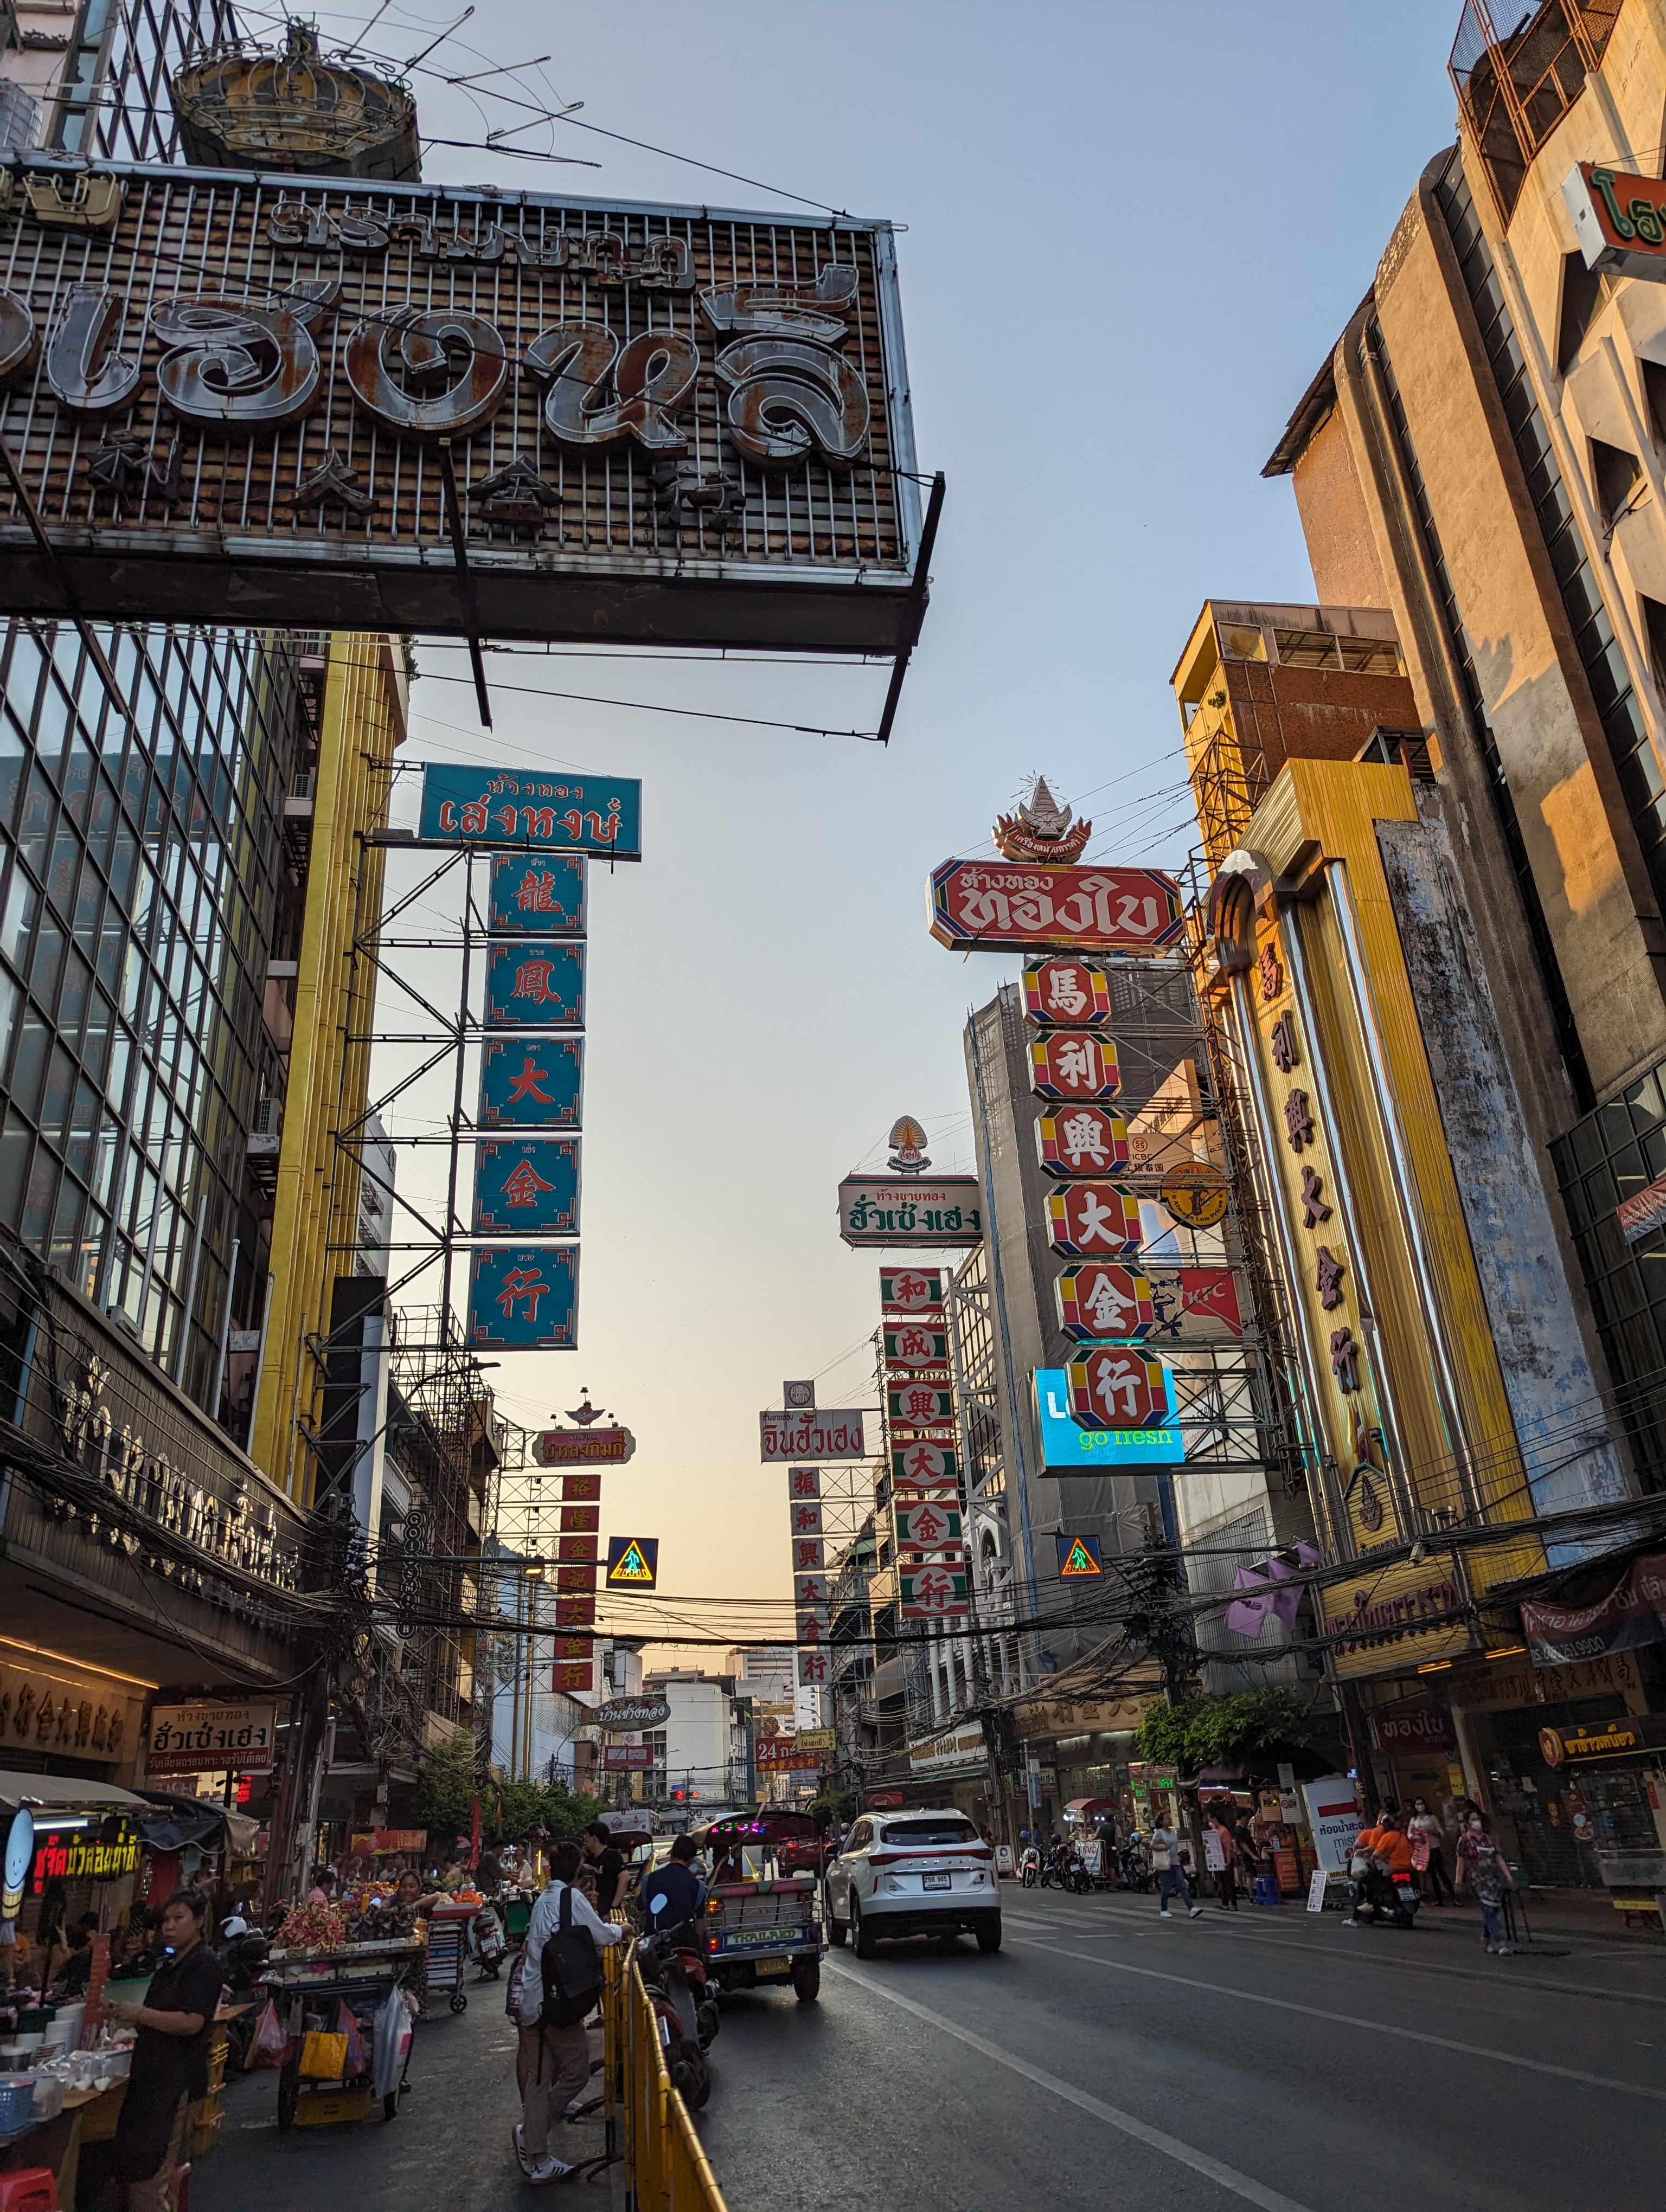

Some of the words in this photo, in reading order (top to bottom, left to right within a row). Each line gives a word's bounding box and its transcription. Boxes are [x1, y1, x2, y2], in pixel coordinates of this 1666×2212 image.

[487, 774, 584, 800] ห้างทอง
[439, 793, 624, 844] เล่งหงษ์
[1014, 832, 1080, 853] เครื่องหมายการค้า
[531, 858, 546, 867] ห้าง
[959, 868, 1053, 891] ห้างทอง
[522, 1144, 536, 1154] เล่ง
[876, 1187, 946, 1201] ห้างขายทอง
[848, 1193, 981, 1232] ฮั่วเซ่งเฮง
[1188, 1282, 1226, 1304] KFC
[1079, 1430, 1110, 1451] go
[1114, 1430, 1174, 1445] fresh
[177, 1709, 249, 1722] ห้างขายทอง
[599, 1703, 665, 1722] บ้านช่างทอง
[153, 1721, 266, 1751] ฮั่วเซ่งเฮง
[149, 1752, 218, 1769] รับเลี่ยมกรอบพระ
[221, 1750, 267, 1766] รอรับได้เลย
[759, 1742, 778, 1760] 24
[1319, 1819, 1364, 1836] ห้องน้ำสะอ
[1334, 1836, 1356, 1849] mist
[733, 1929, 796, 1944] THAILAND
